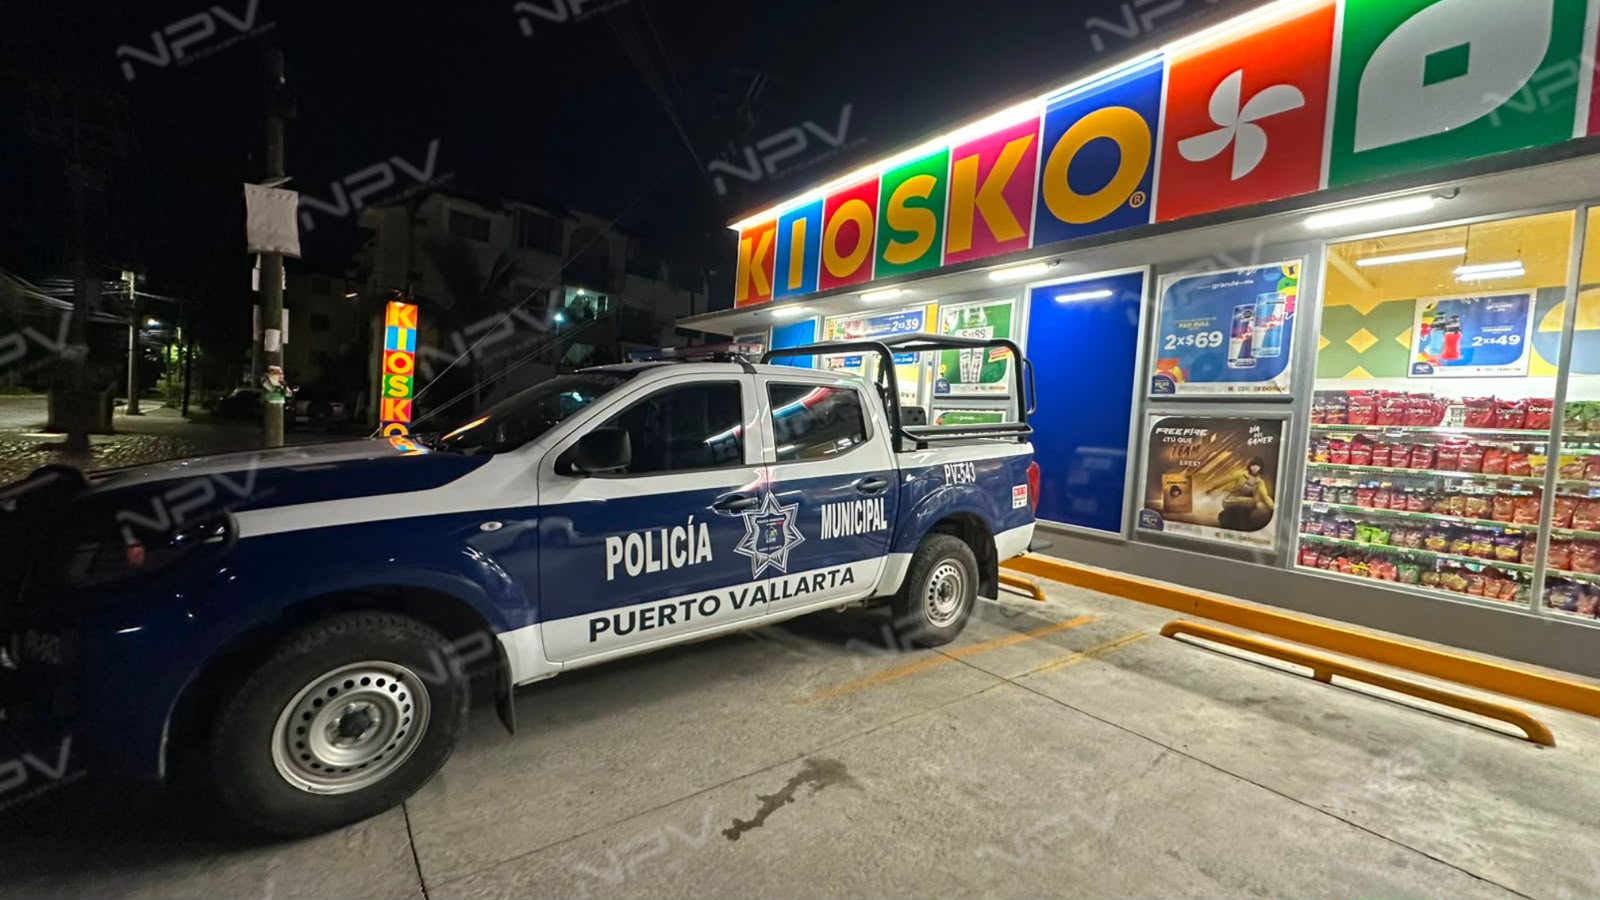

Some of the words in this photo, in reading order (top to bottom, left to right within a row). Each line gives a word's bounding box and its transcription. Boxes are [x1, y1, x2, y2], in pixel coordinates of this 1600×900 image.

[740, 106, 1152, 301] KIOSKO
[1164, 330, 1224, 350] 2x$69
[944, 462, 977, 487] PV-543
[820, 498, 888, 541] MUNICIPAL
[605, 514, 713, 581] POLICÍA
[589, 596, 721, 642] PUERTO
[731, 566, 855, 611] VALLARTA
